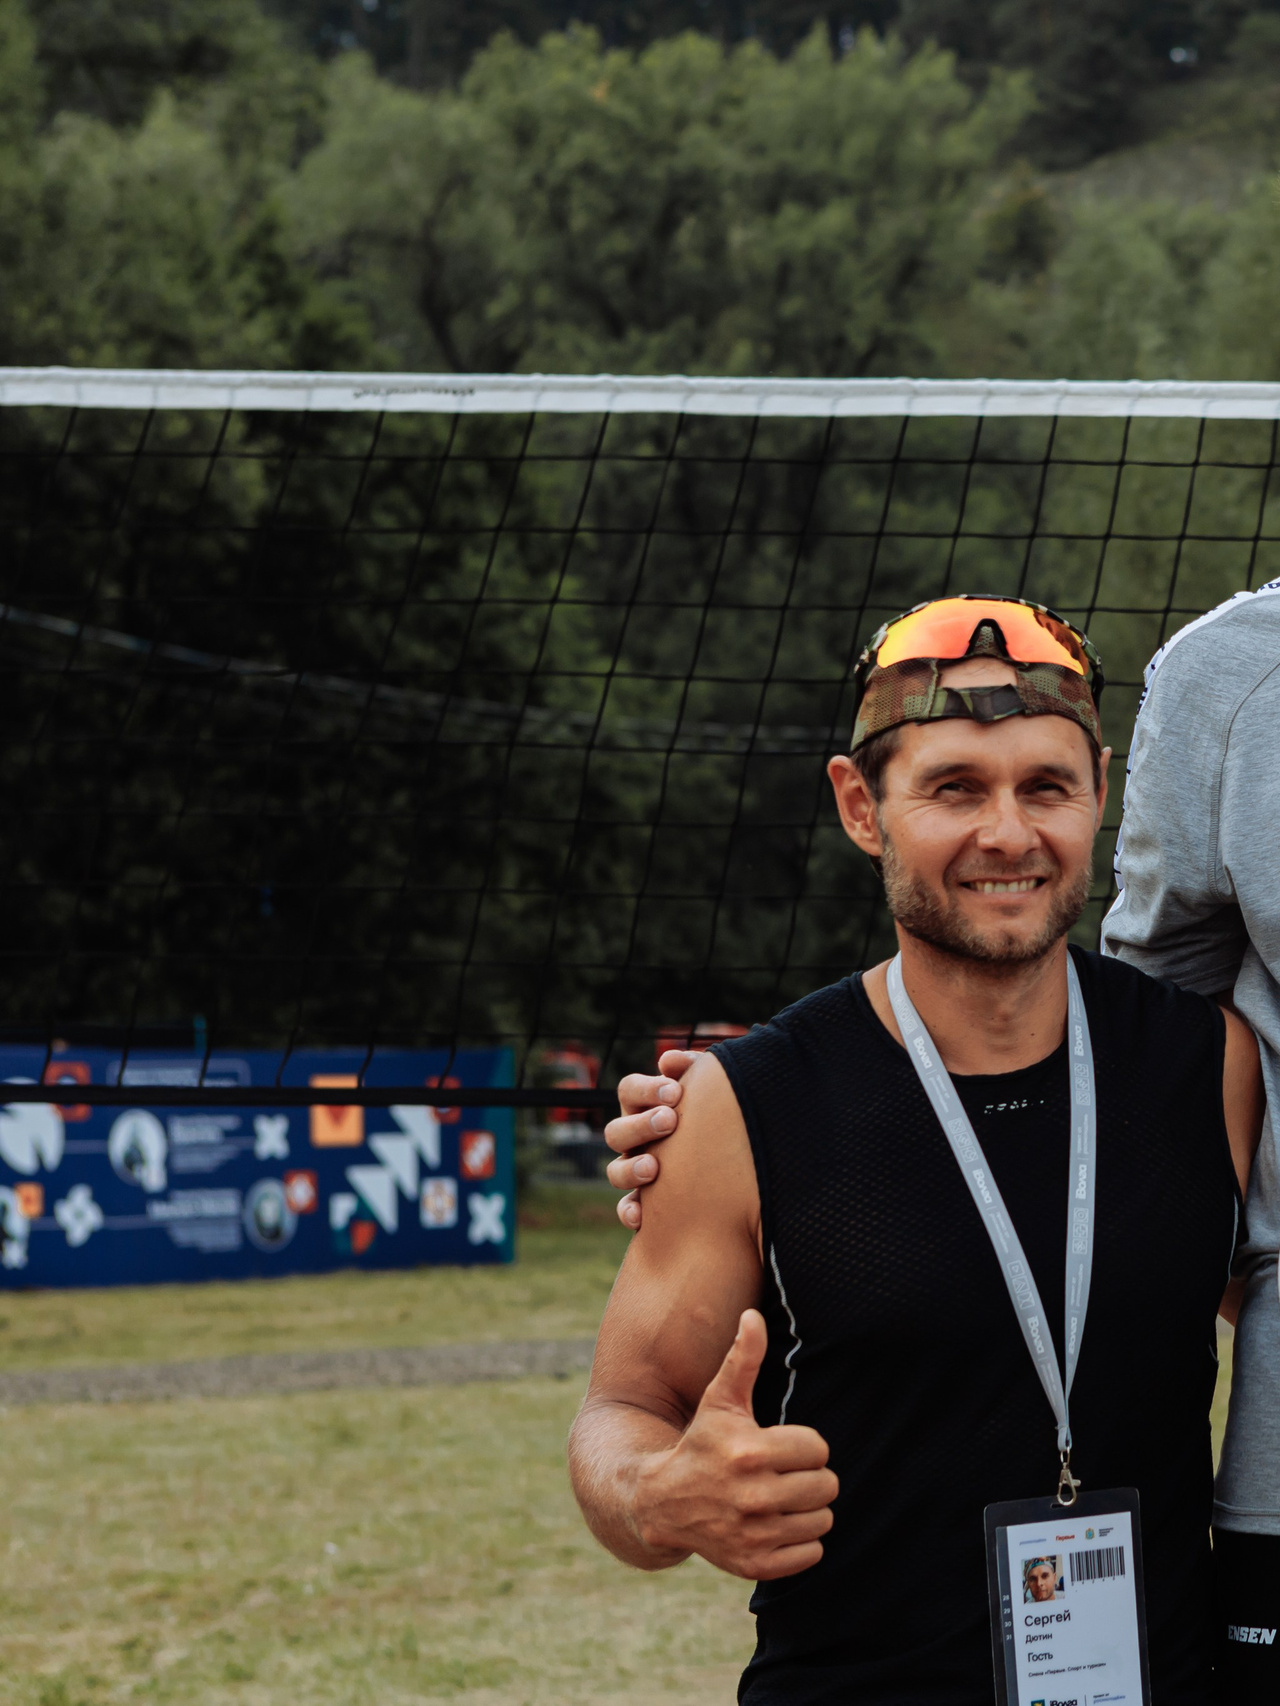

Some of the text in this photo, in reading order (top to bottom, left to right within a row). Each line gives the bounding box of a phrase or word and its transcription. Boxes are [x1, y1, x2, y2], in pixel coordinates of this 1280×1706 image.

[1024, 1609, 1071, 1628] Сергей
[1025, 1633, 1053, 1644] Дютин
[1228, 1625, 1277, 1645] ENSEN
[1027, 1652, 1054, 1663] Гость
